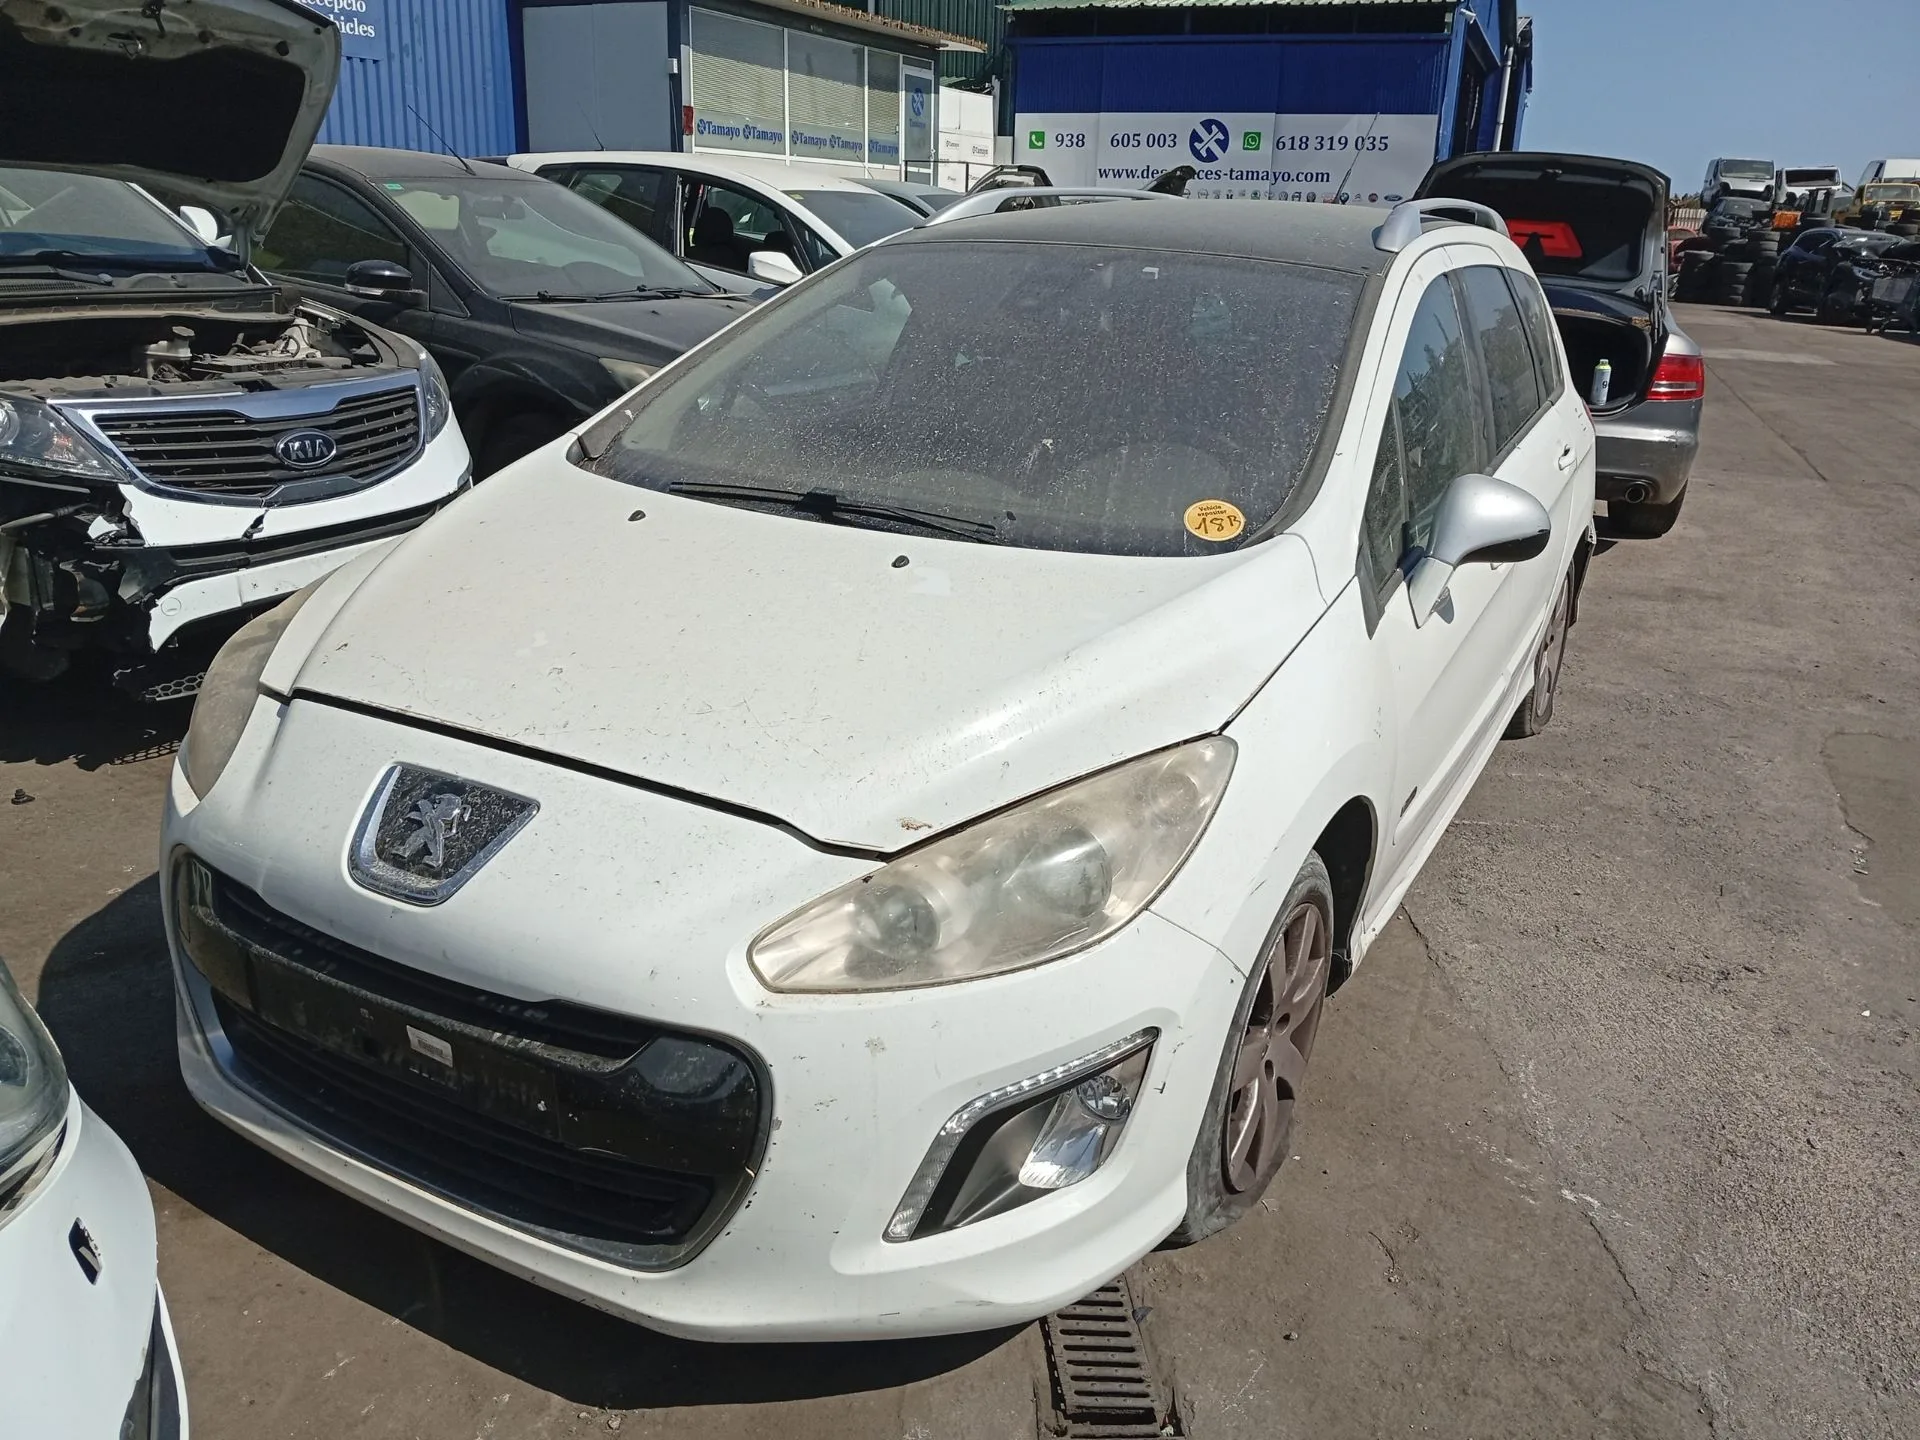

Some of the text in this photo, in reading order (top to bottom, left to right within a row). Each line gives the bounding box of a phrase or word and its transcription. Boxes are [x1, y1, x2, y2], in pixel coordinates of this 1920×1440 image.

[706, 121, 783, 145] Tamayo Tamayo
[799, 133, 863, 153] Tamayo Tamayo
[1055, 133, 1178, 148] 938 605 003
[1276, 135, 1389, 152] 618 319 035
[288, 439, 329, 461] KIA
